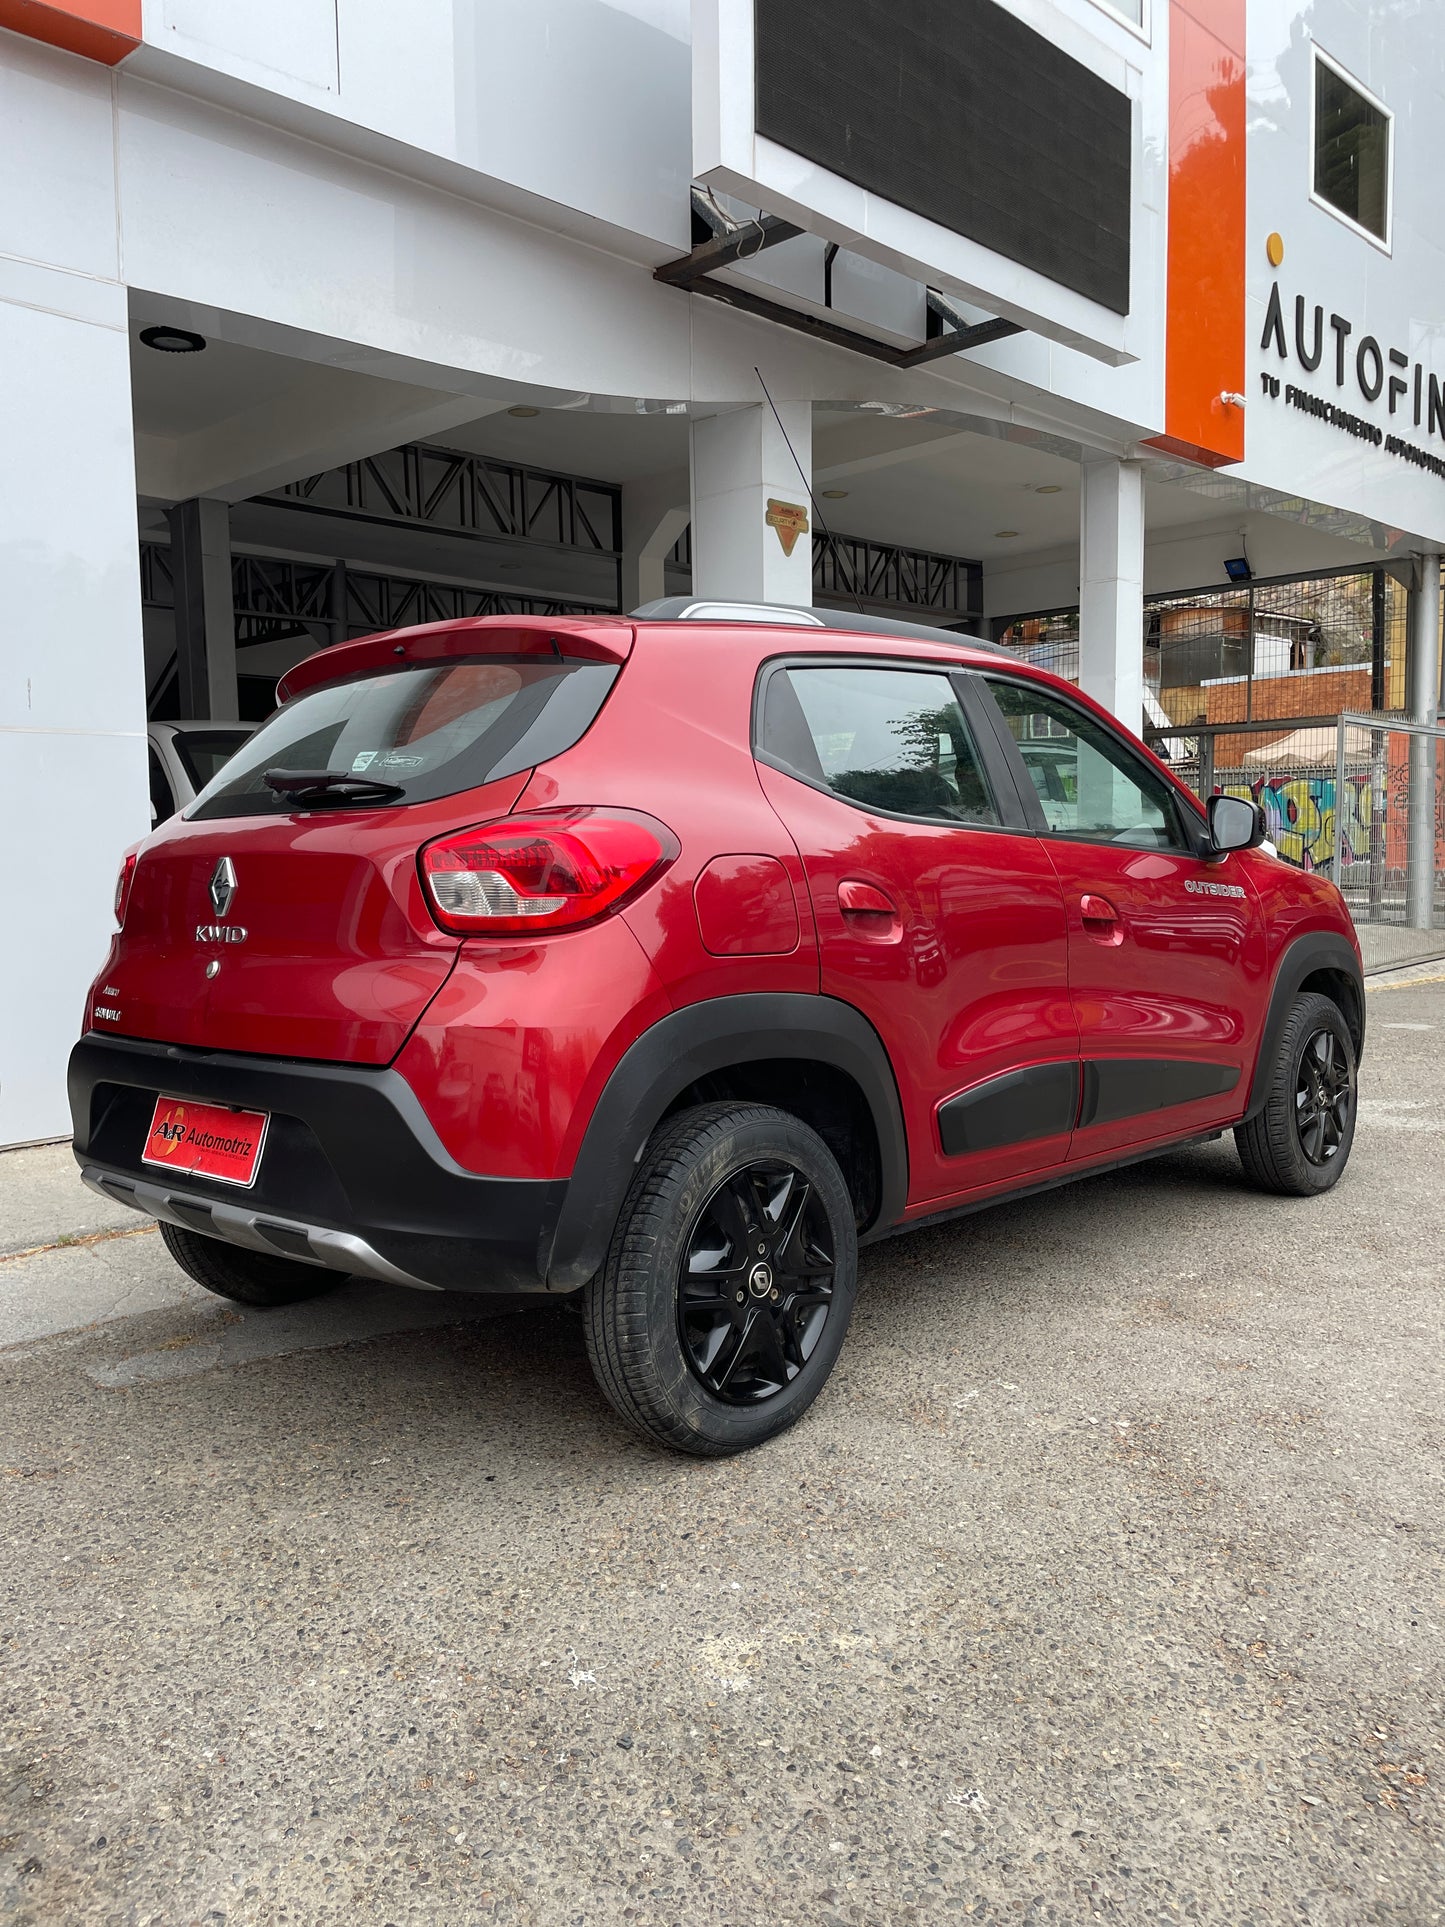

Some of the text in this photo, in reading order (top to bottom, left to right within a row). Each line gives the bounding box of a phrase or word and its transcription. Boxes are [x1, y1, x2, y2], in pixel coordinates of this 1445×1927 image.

[1260, 372, 1280, 398] TU
[1285, 384, 1383, 446] FINANCIAMENTO
[1184, 879, 1247, 899] OUTSIDER
[195, 925, 249, 944] KWID
[153, 1121, 186, 1142] A&R
[186, 1127, 253, 1156] Automotriz
